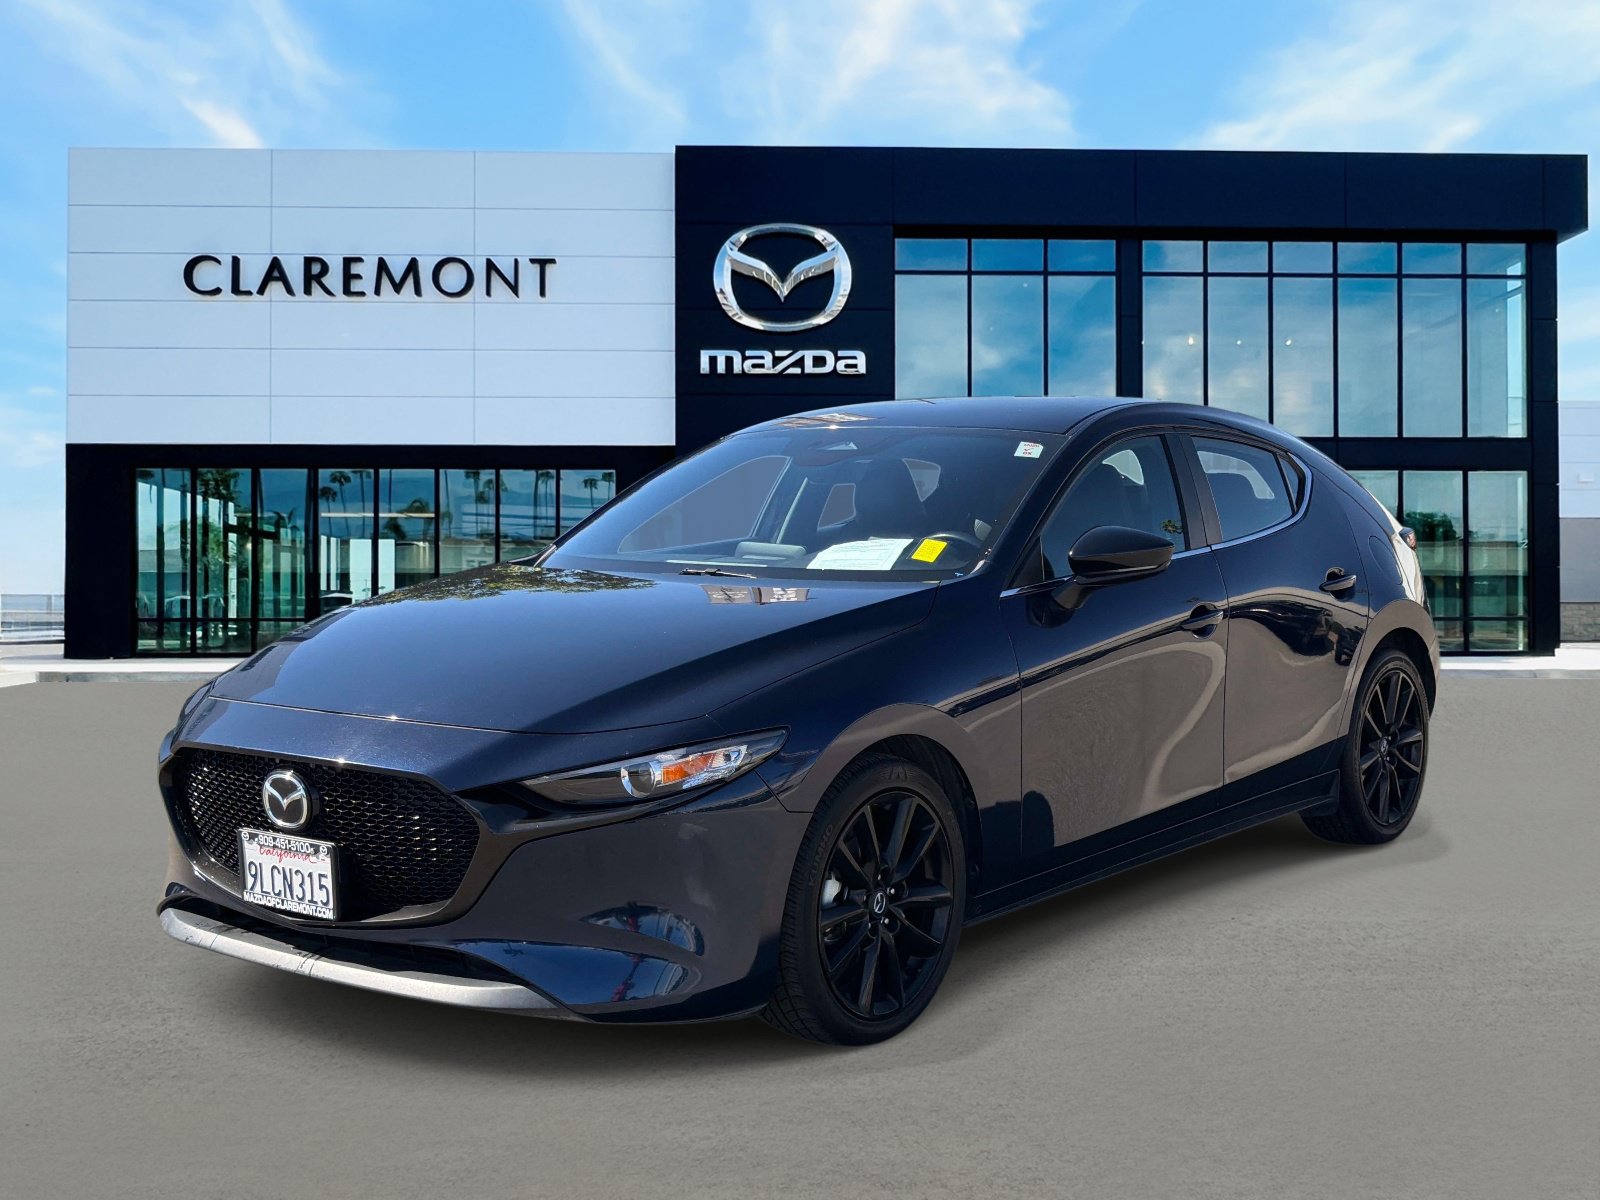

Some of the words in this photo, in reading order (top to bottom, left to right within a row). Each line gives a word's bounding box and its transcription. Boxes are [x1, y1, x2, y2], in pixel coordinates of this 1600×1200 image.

[184, 254, 557, 298] CLAREMONT
[258, 835, 310, 853] 909-451-5100
[248, 861, 330, 906] 9LCN315
[243, 892, 333, 919] MAZDAOFCLAREMONT.COM
